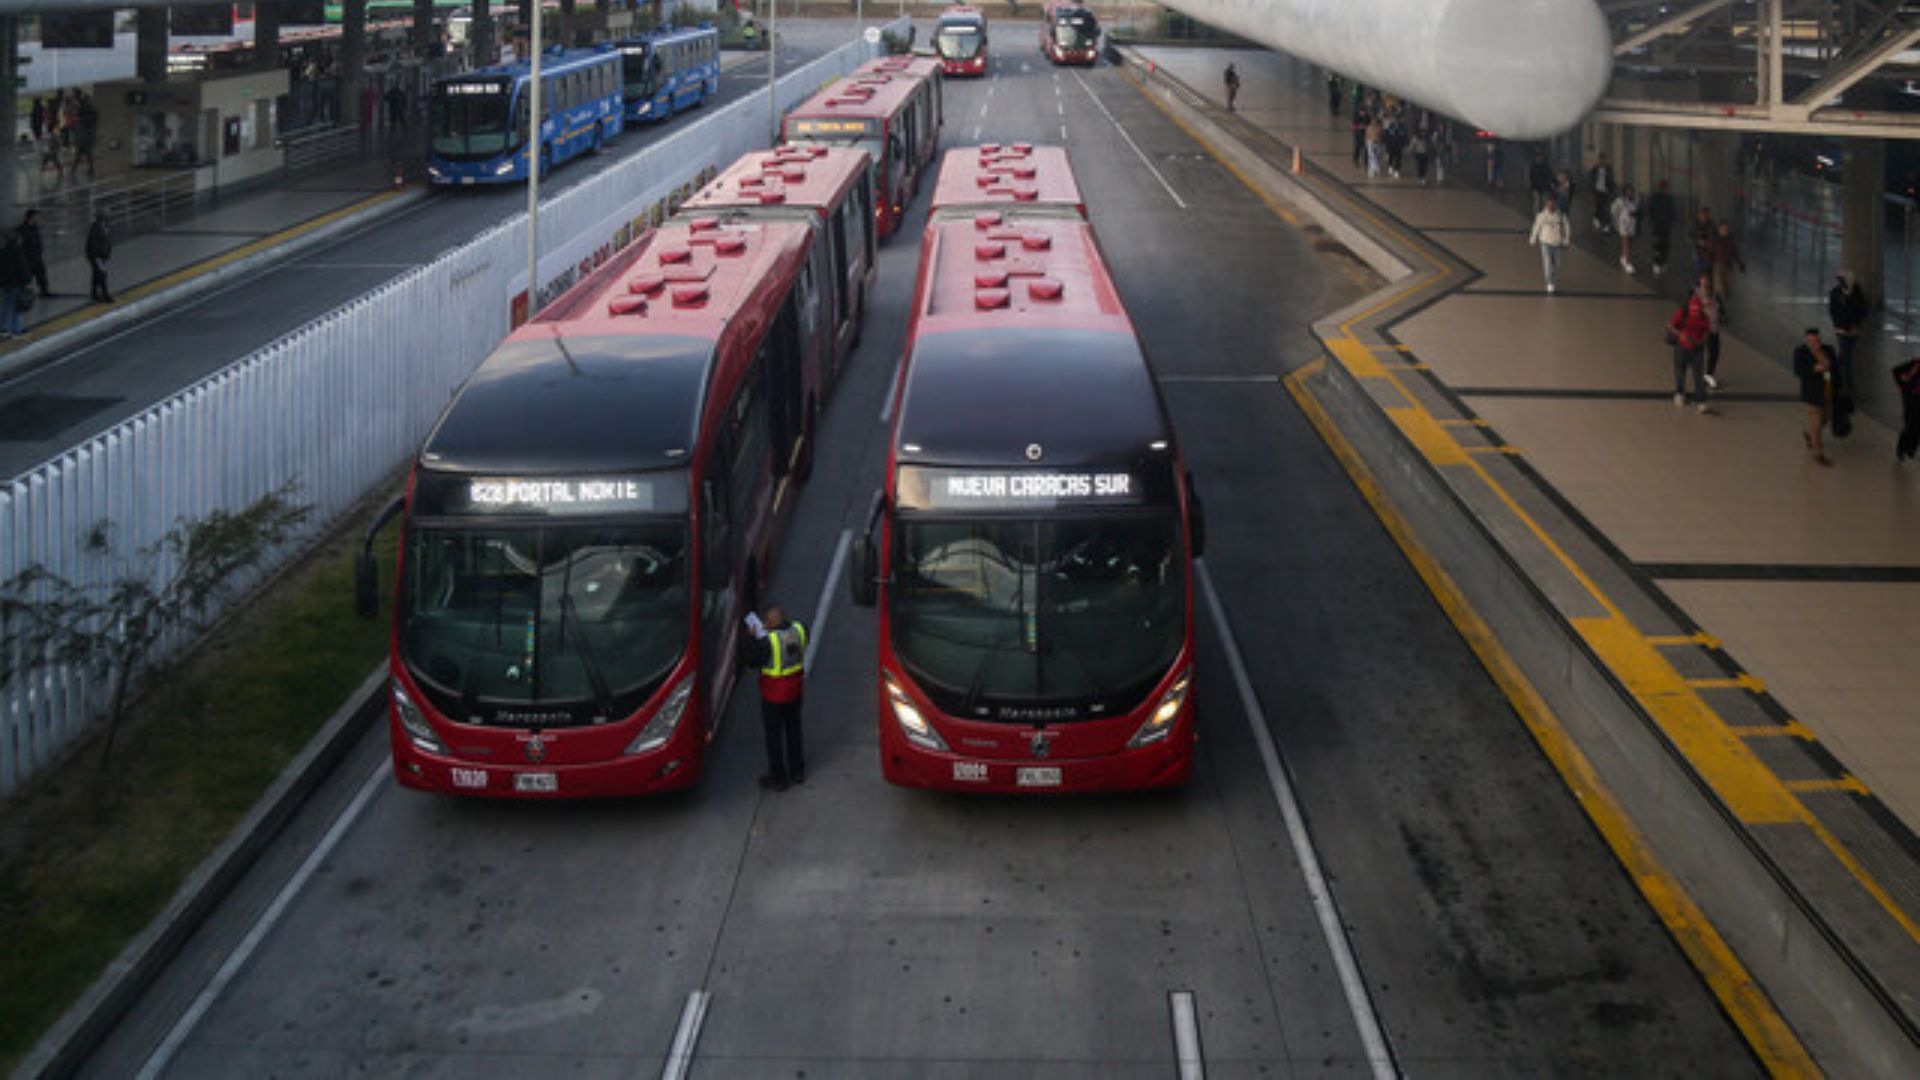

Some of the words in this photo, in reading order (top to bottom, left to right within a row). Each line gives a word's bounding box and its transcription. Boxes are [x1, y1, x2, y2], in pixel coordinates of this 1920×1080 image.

[506, 480, 574, 503] PORTAL
[947, 476, 1006, 497] NUEVA
[1010, 474, 1091, 497] CARACAS
[1094, 473, 1130, 495] SUR
